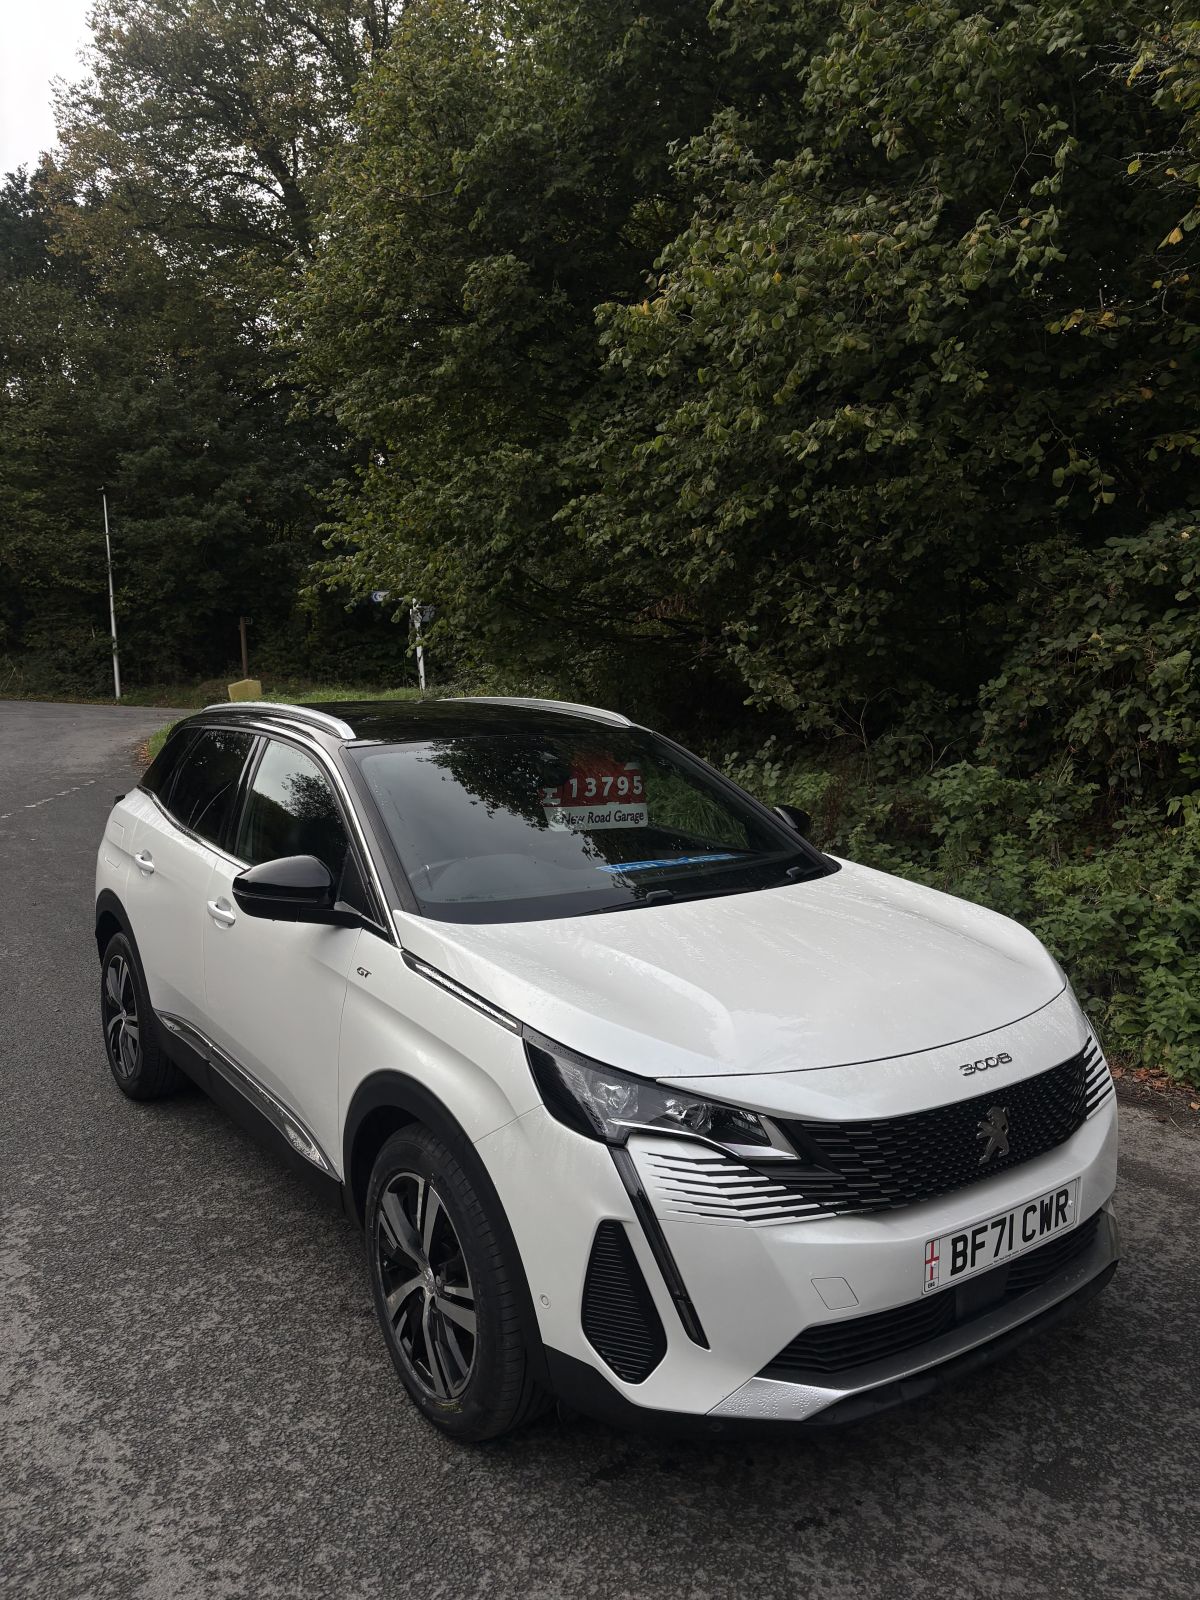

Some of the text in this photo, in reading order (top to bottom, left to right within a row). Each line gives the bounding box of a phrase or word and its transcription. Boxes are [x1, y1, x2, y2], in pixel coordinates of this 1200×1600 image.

[561, 810, 644, 825] New Road Garage
[357, 966, 372, 978] GT
[959, 1053, 1012, 1076] 3008
[951, 1188, 1068, 1276] BF71 CWR
